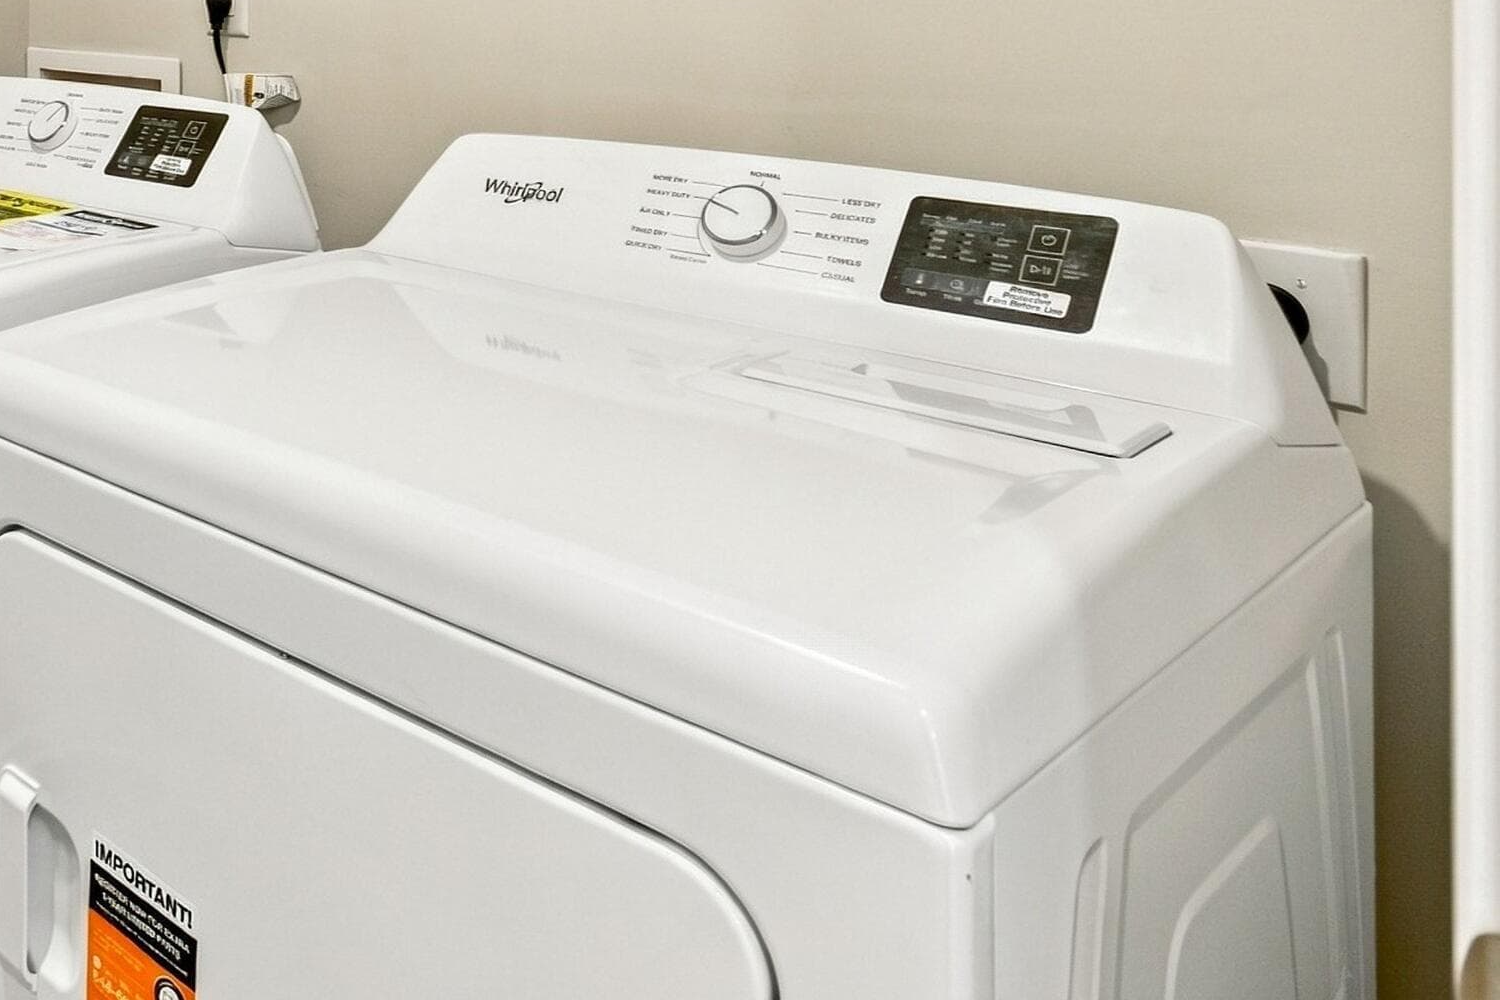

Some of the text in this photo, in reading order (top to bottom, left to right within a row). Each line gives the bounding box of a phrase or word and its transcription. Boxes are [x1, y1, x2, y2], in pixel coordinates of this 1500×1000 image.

[750, 171, 781, 180] NORMAL
[485, 178, 564, 203] Whirlpool
[647, 188, 670, 196] HEAVY
[842, 198, 881, 209] LESS DRY
[651, 208, 671, 216] ONLY
[830, 212, 876, 224] DELICATES
[625, 240, 647, 249] QUICK
[815, 231, 870, 246] BULKY ITEMS
[827, 255, 862, 267] TOWELS
[821, 271, 855, 283] CASUAL
[94, 839, 193, 929] IMPORTANT!
